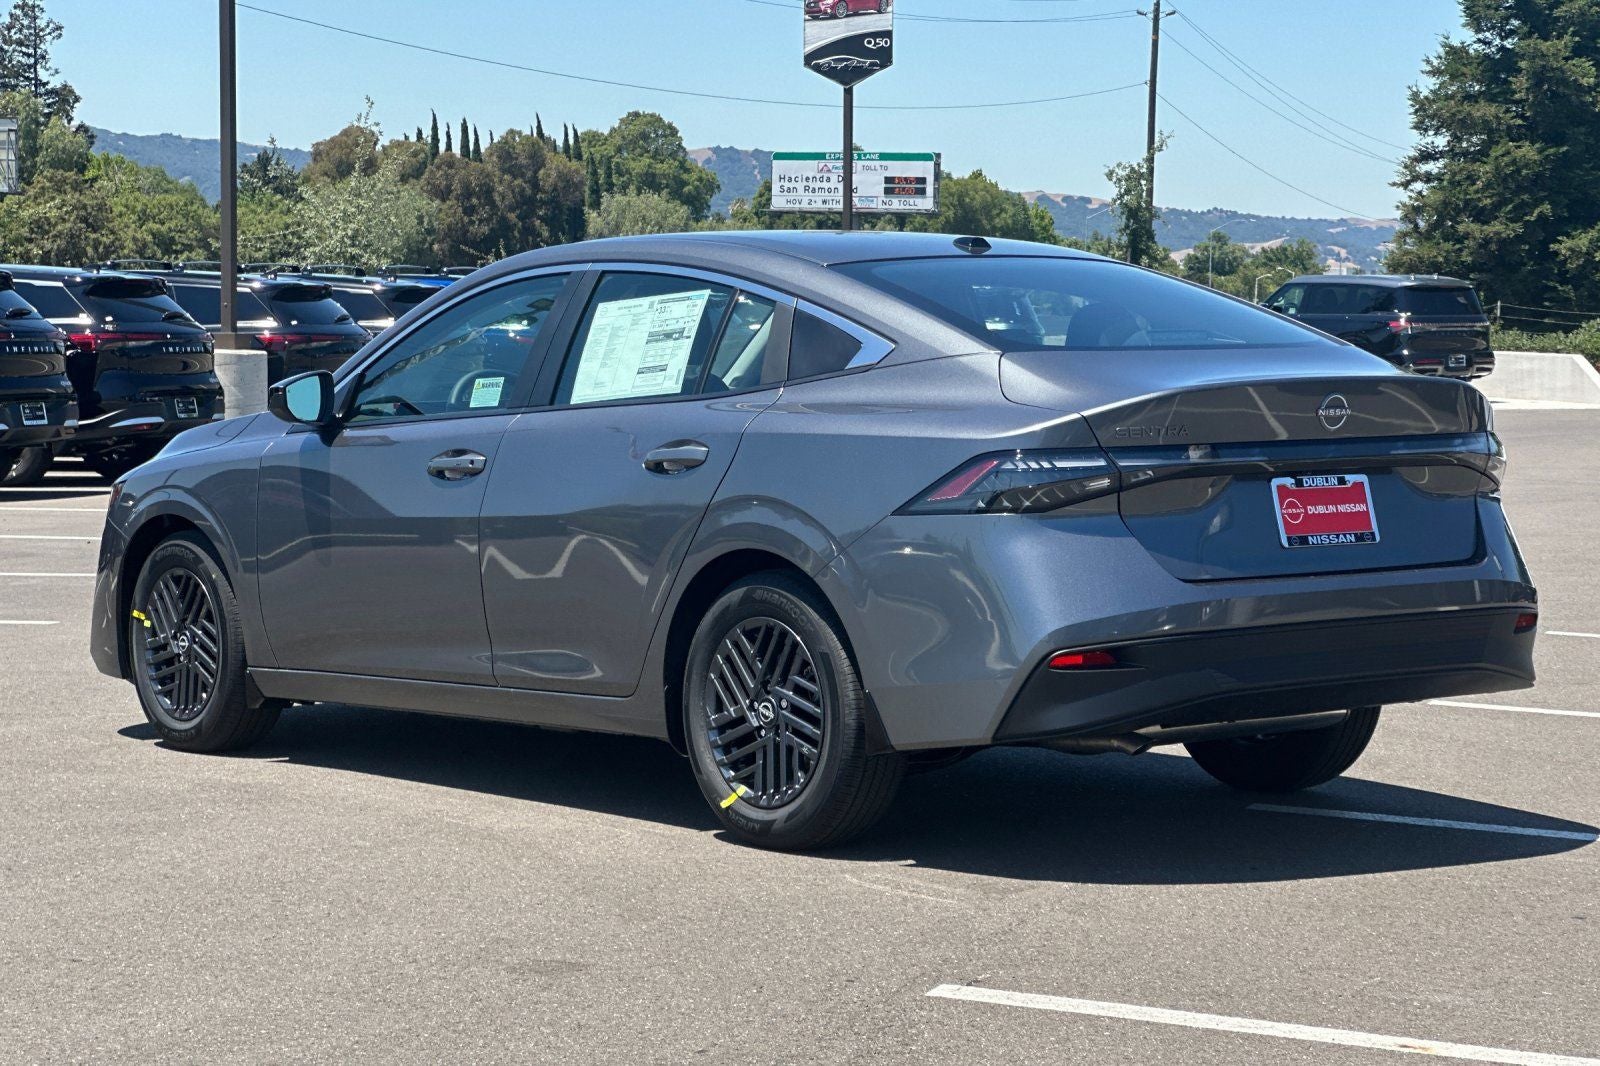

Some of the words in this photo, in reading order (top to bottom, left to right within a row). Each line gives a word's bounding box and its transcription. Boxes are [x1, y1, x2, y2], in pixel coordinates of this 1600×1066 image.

[864, 38, 890, 49] Q50
[779, 174, 831, 183] Hacienda
[779, 185, 798, 194] San
[803, 185, 839, 194] Ramon
[786, 198, 804, 206] HOV
[821, 198, 841, 206] WITH
[881, 199, 893, 207] NO
[897, 199, 918, 207] TOLL
[1318, 408, 1351, 416] NISSAN
[1115, 425, 1190, 439] SENTRA
[1303, 476, 1338, 487] DUBLIN
[1307, 504, 1337, 514] DUBLIN
[1338, 503, 1367, 513] NISSAN
[1309, 534, 1355, 545] NISSAN
